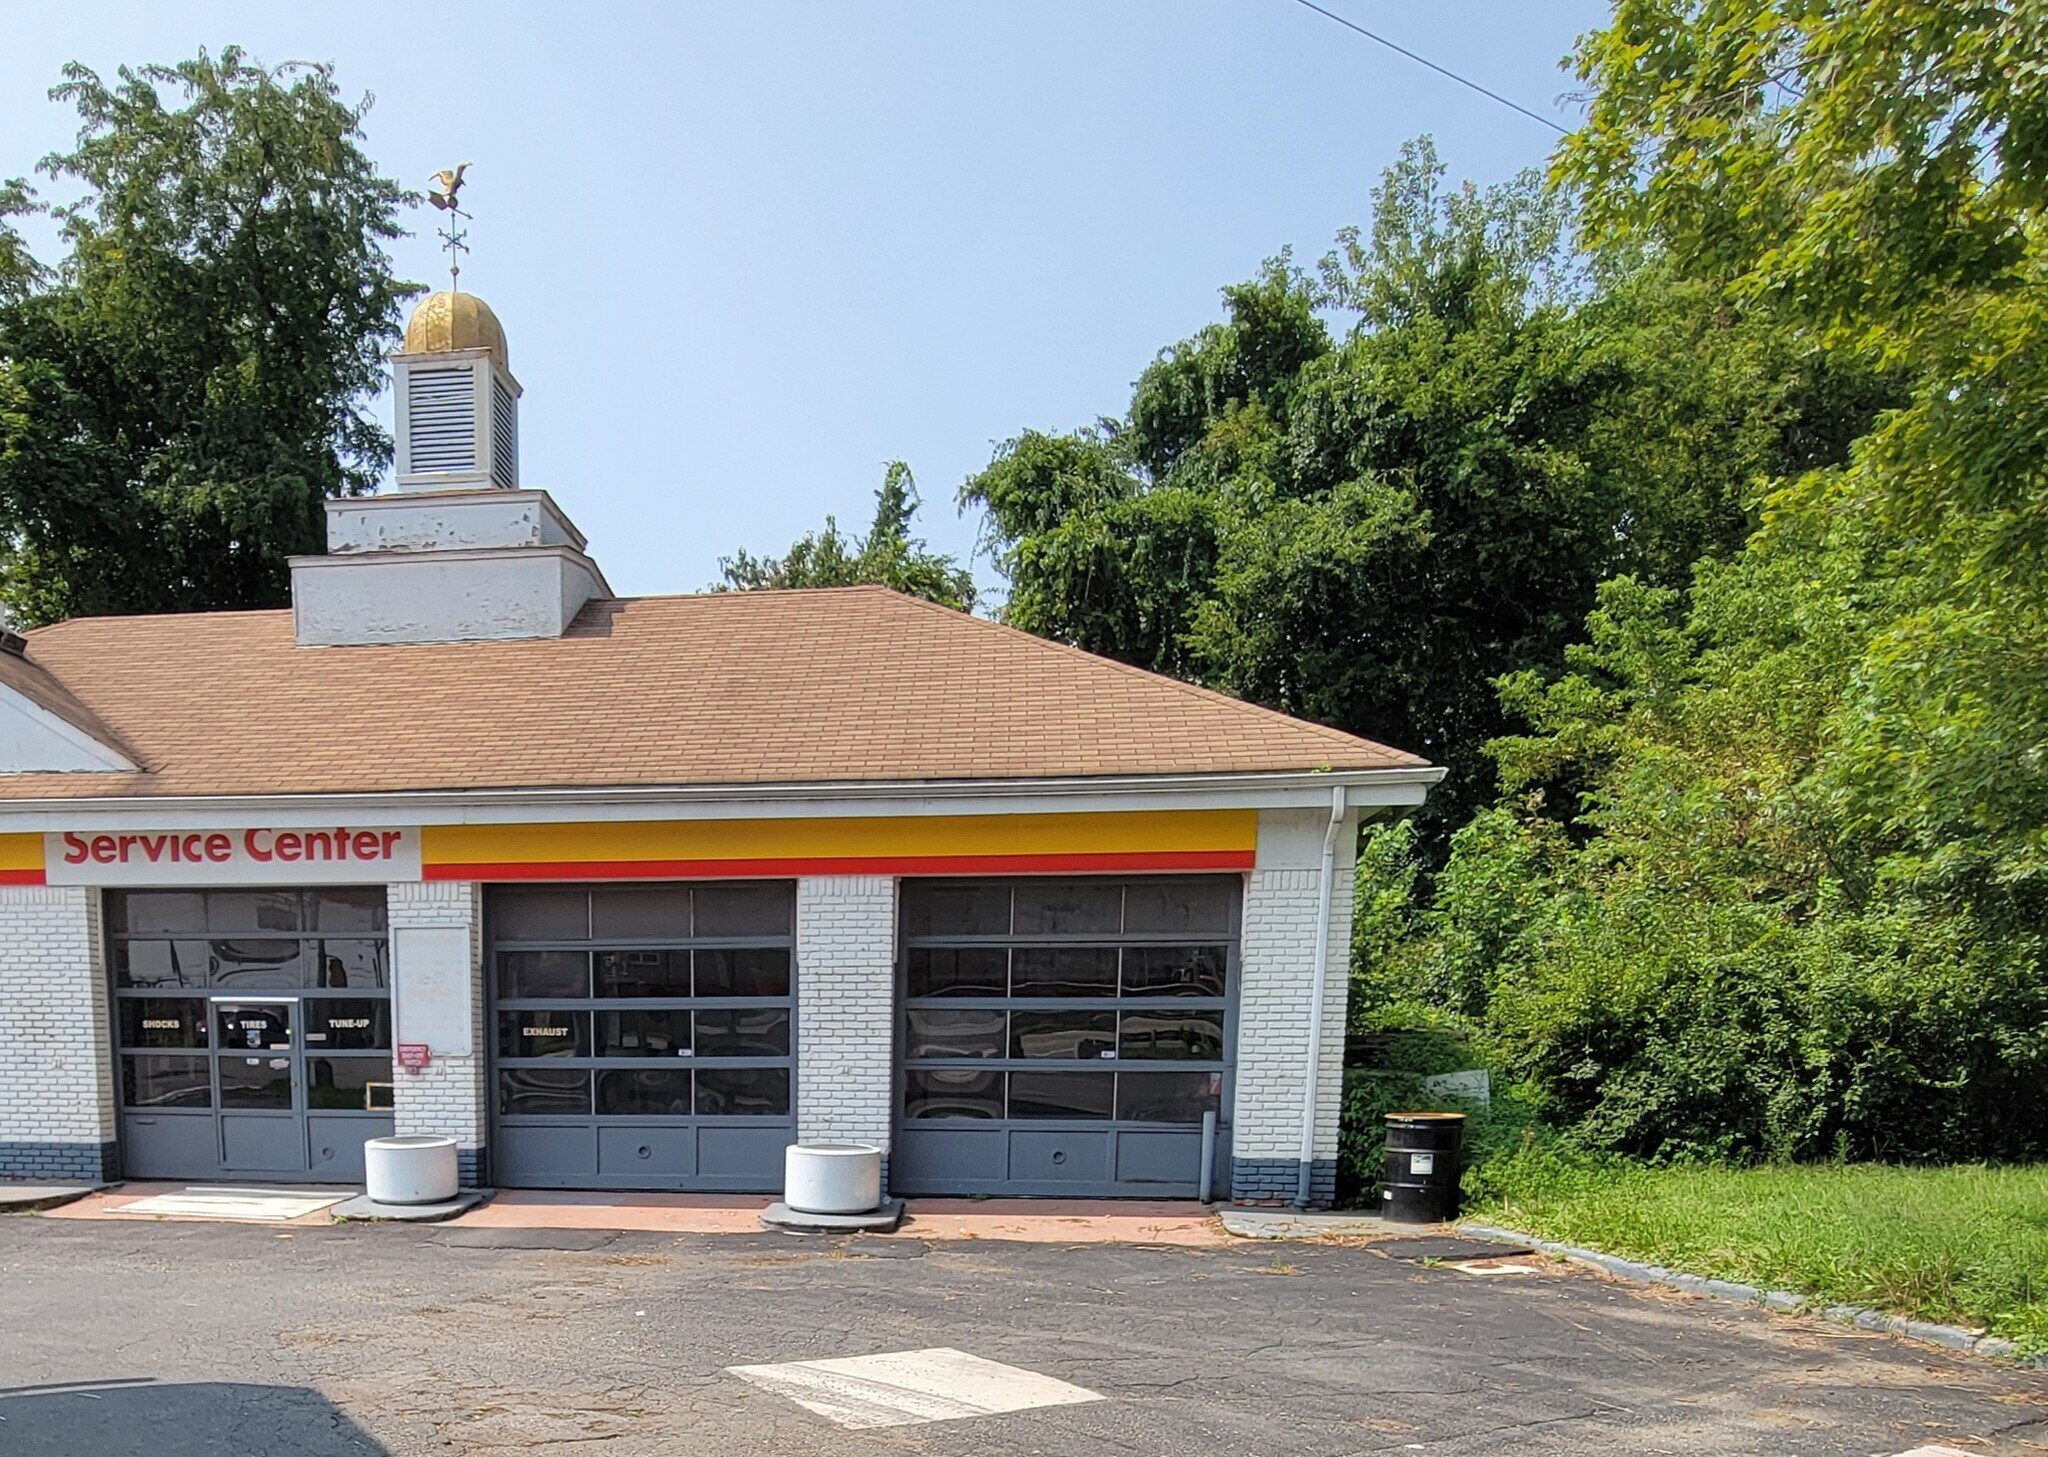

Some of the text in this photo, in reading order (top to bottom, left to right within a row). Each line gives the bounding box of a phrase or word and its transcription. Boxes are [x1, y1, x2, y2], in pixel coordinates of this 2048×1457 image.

[63, 826, 402, 864] Service Center
[142, 1020, 180, 1029] SHOCKS
[240, 1020, 268, 1029] TIRES
[328, 1019, 370, 1028] TUNE-UP
[523, 1027, 569, 1036] EXHAUST
